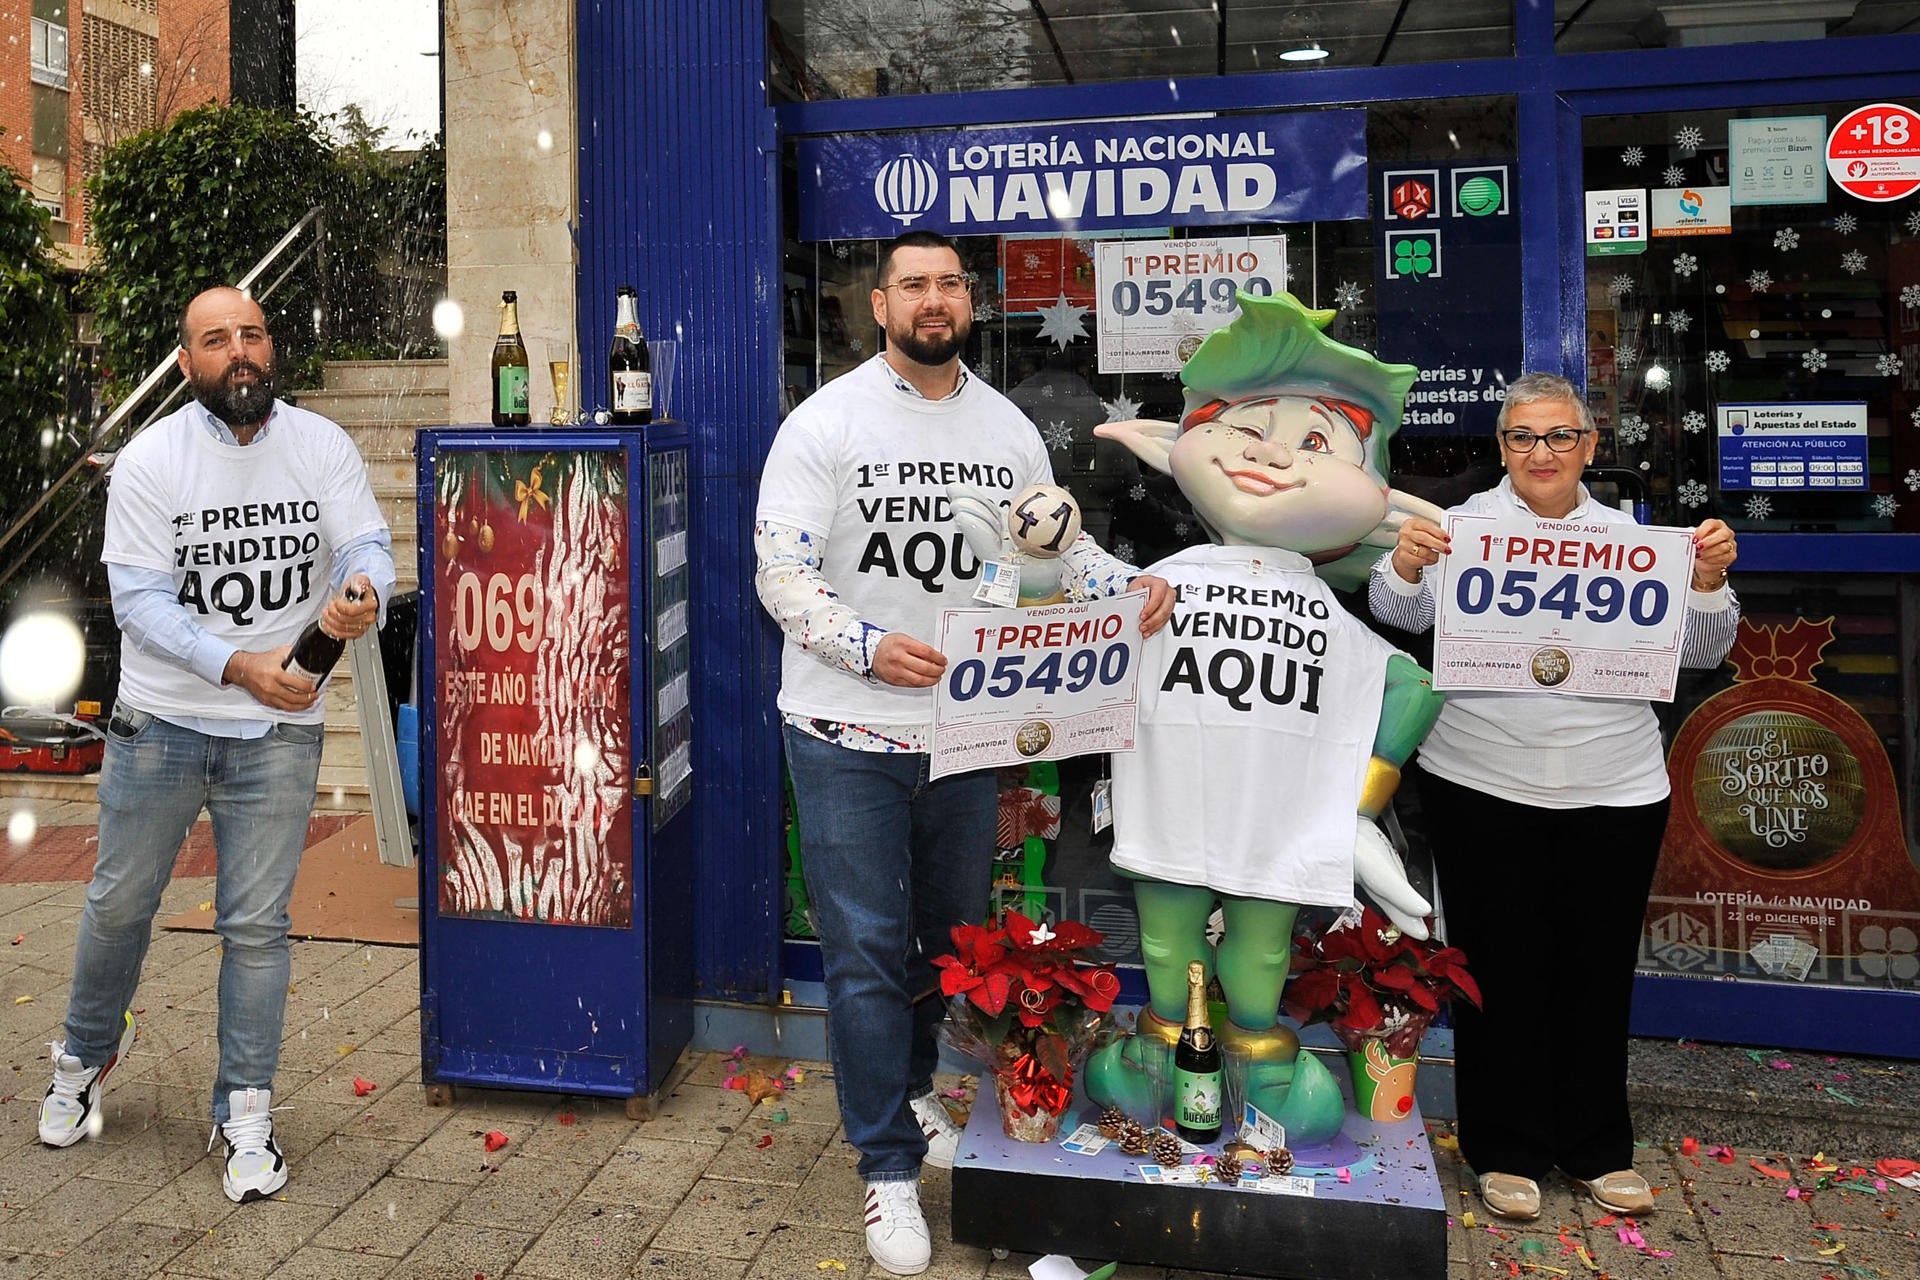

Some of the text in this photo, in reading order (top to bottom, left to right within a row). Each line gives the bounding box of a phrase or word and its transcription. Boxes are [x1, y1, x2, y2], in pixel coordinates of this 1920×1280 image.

[1850, 114, 1910, 146] +18
[948, 131, 1275, 171] LOTERÍA NACIONAL
[1787, 144, 1813, 152] Bizum
[949, 162, 1277, 223] NAVIDAD
[1163, 241, 1198, 249] VENDIDO
[1145, 252, 1259, 276] PREMIO
[1415, 364, 1484, 385] erías y
[1404, 386, 1479, 408] puestas
[1401, 407, 1456, 425] stado
[1753, 410, 1803, 420] Loterías y
[1753, 420, 1857, 431] Apuestas del Estado
[1742, 439, 1789, 448] ATENCIÓN
[1804, 439, 1847, 448] PÚBLICO
[898, 461, 1014, 490] PREMIO
[1780, 477, 1804, 485] 21:00
[1810, 477, 1834, 485] 09:00
[1810, 463, 1834, 471] 09:00
[202, 499, 320, 533] PREMIO
[857, 496, 1012, 523] VEND
[1535, 521, 1609, 535] VENDIDO AQUÍ
[175, 532, 320, 568] VENDIDO
[857, 531, 982, 594] AQU
[1505, 536, 1656, 573] PREMIO
[177, 555, 314, 626] AQUÍ
[1205, 584, 1330, 620] PREMIO
[1456, 567, 1669, 627] 05490
[1026, 604, 1090, 617] VENDIDO AQUÍ
[997, 614, 1123, 651] PREMIO
[1170, 611, 1328, 656] VENDIDO
[949, 642, 1130, 701] 05490
[1160, 646, 1324, 715] AQUÍ
[1446, 658, 1477, 669] LOTERÍA
[1486, 661, 1522, 670] NAVIDAD
[1594, 668, 1604, 676] 22
[1605, 669, 1650, 679] DICIEMBRE
[445, 670, 487, 704] ESTE
[490, 665, 526, 706] AÑO
[480, 732, 502, 765] DE
[941, 742, 968, 756] LOTERÍA
[975, 738, 1008, 749] NAVIDAD
[1069, 731, 1077, 739] 22
[1077, 725, 1115, 738] DICIEMBRE
[1746, 730, 1793, 761] EL
[1720, 754, 1829, 796] SORTEO
[452, 791, 485, 824] CAE
[490, 792, 512, 825] EN
[517, 793, 538, 826] EL
[1748, 779, 1829, 809] QUE NOS
[1738, 804, 1808, 848] UNE
[1695, 890, 1872, 911] LOTERÍA de NAVIDAD
[1727, 911, 1836, 926] 22 de DICIEMBRE
